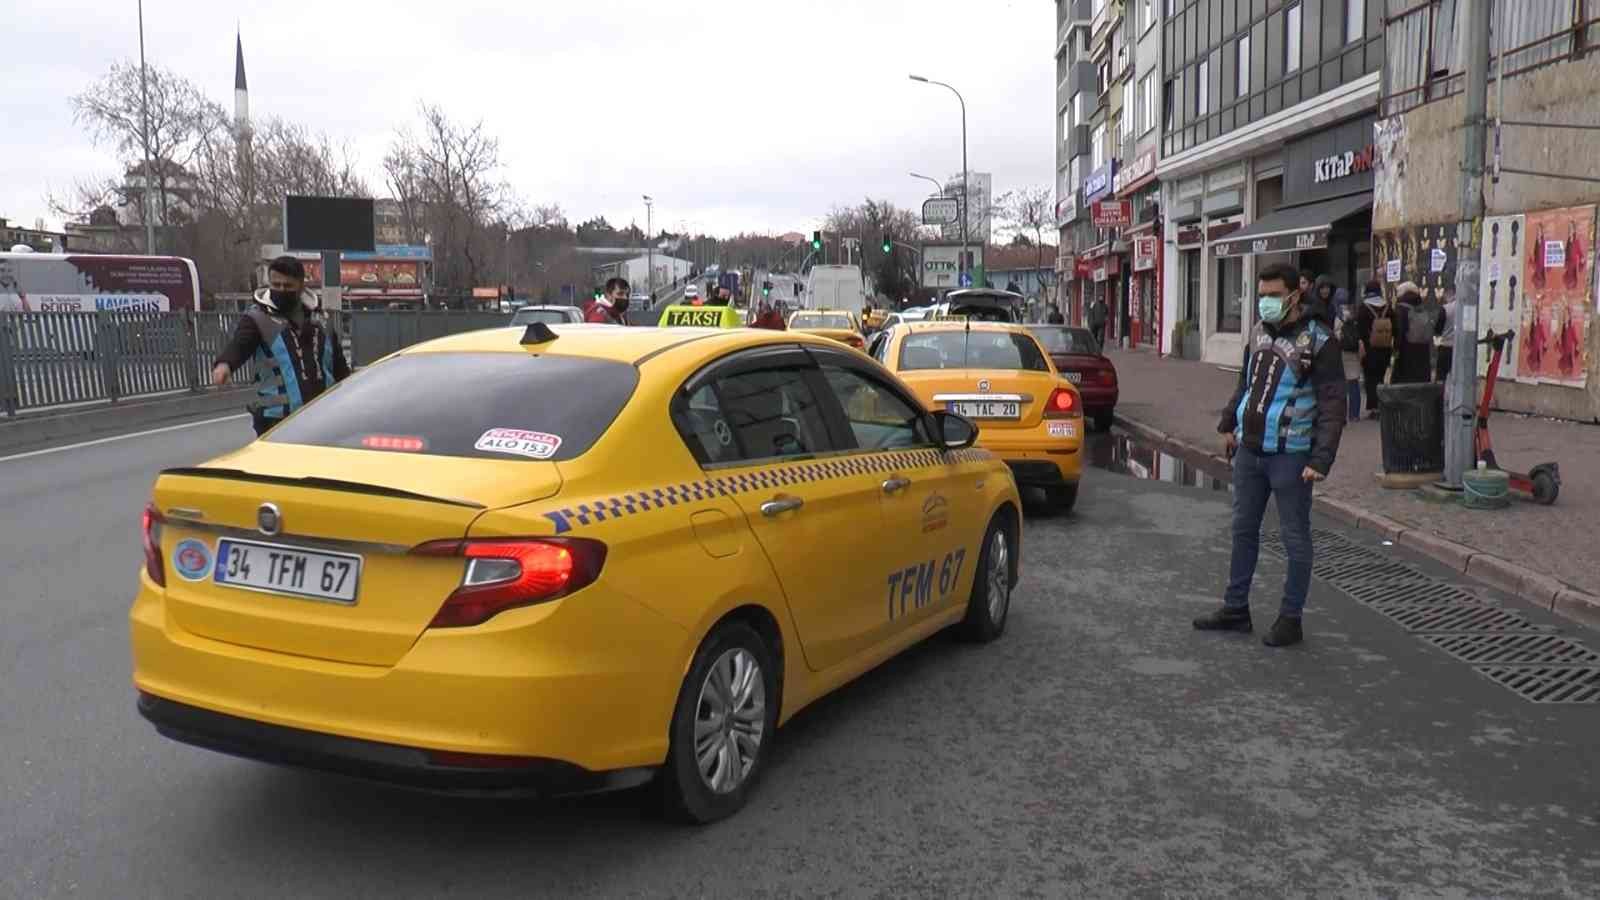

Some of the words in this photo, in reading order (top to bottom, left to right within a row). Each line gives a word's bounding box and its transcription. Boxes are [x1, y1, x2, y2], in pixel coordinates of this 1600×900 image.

[976, 401, 995, 416] TAC
[1003, 401, 1017, 416] 20
[484, 439, 519, 449] ALO
[522, 442, 549, 454] 153
[227, 546, 251, 581] 34
[268, 551, 307, 588] TFM
[321, 560, 351, 594] 67
[888, 559, 936, 624] TFM
[939, 548, 966, 595] 67
